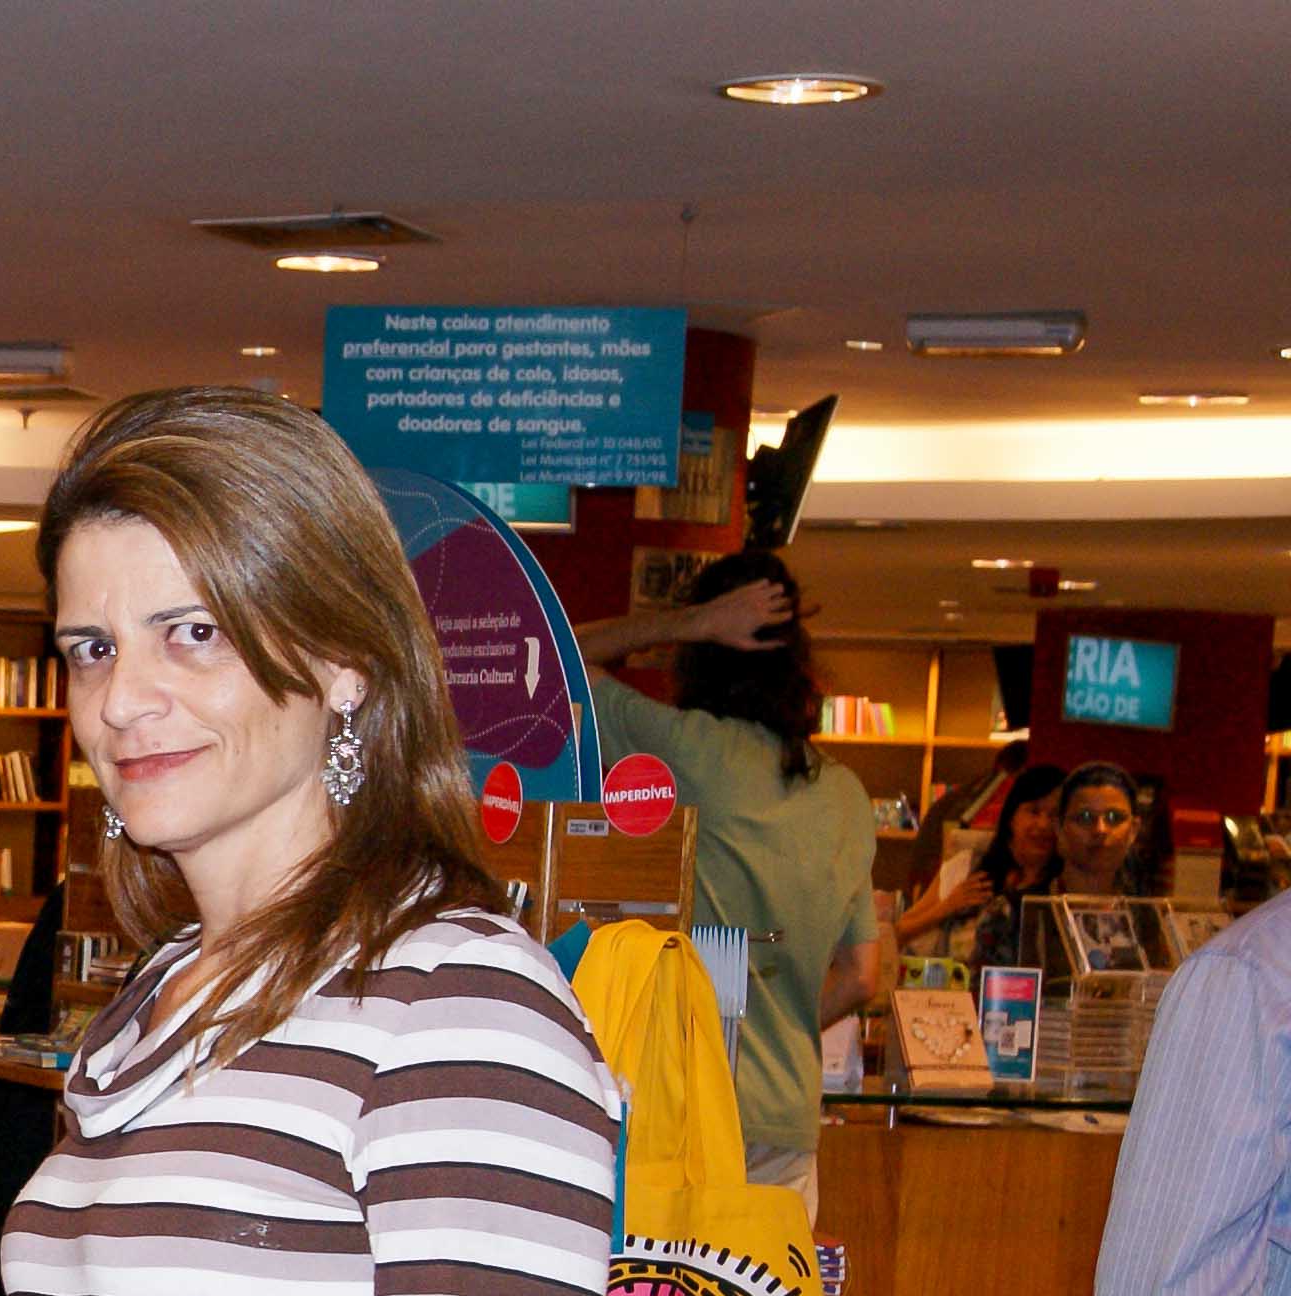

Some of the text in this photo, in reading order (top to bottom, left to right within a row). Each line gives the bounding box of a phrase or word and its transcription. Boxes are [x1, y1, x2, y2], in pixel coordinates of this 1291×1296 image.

[385, 313, 611, 332] Neste caixa atendimento
[343, 338, 651, 360] preferencial para gestantes, mães
[366, 365, 624, 385] com crianças de colo, idosos,
[367, 389, 622, 411] portadores de deficiências e
[398, 414, 587, 436] doadores de sangue.
[1068, 636, 1140, 688] RIA
[605, 783, 675, 805] IMPERDÍVEL
